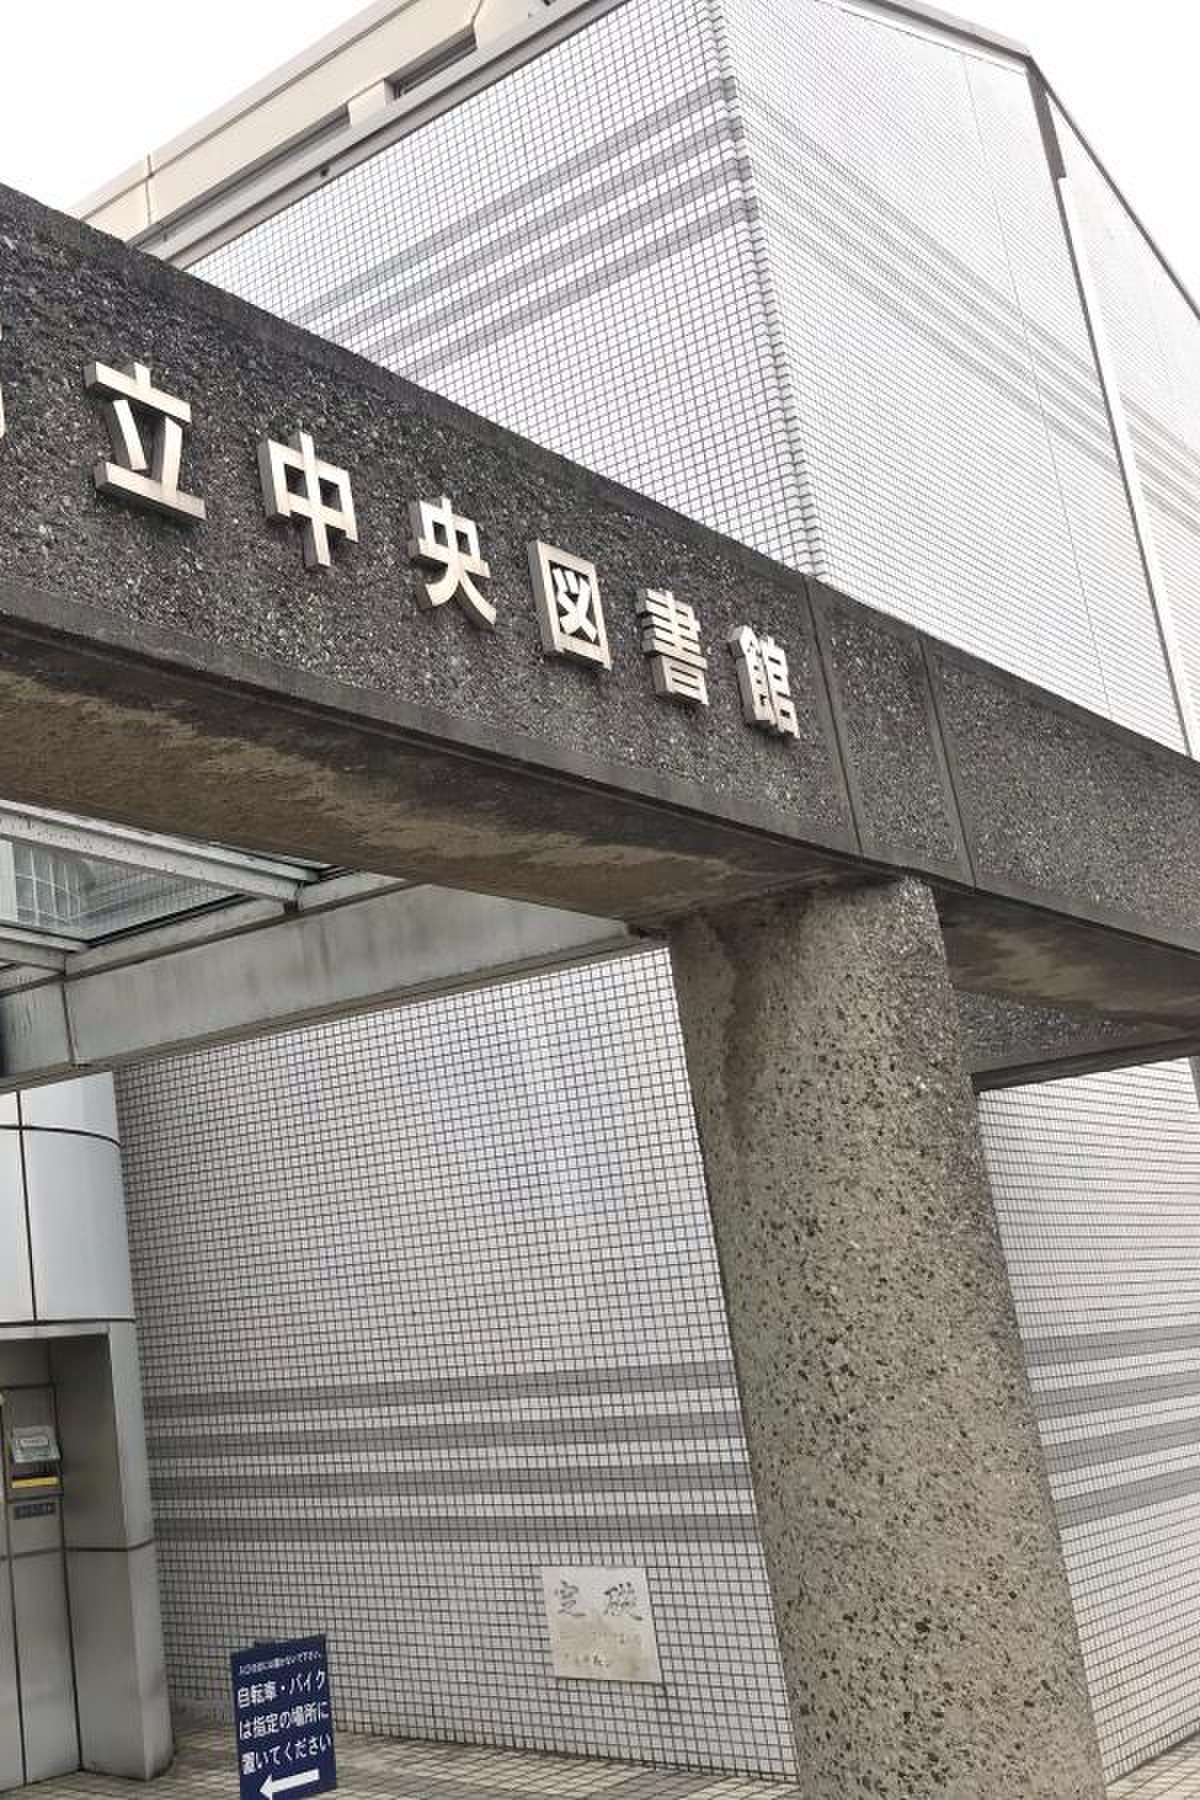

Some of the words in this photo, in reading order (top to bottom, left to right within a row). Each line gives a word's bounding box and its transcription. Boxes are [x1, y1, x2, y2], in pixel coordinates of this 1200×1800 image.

[237, 1670, 327, 1709] 自転車・バイク
[239, 1701, 330, 1740] は指定の場所に
[241, 1735, 332, 1776] 置いてください
